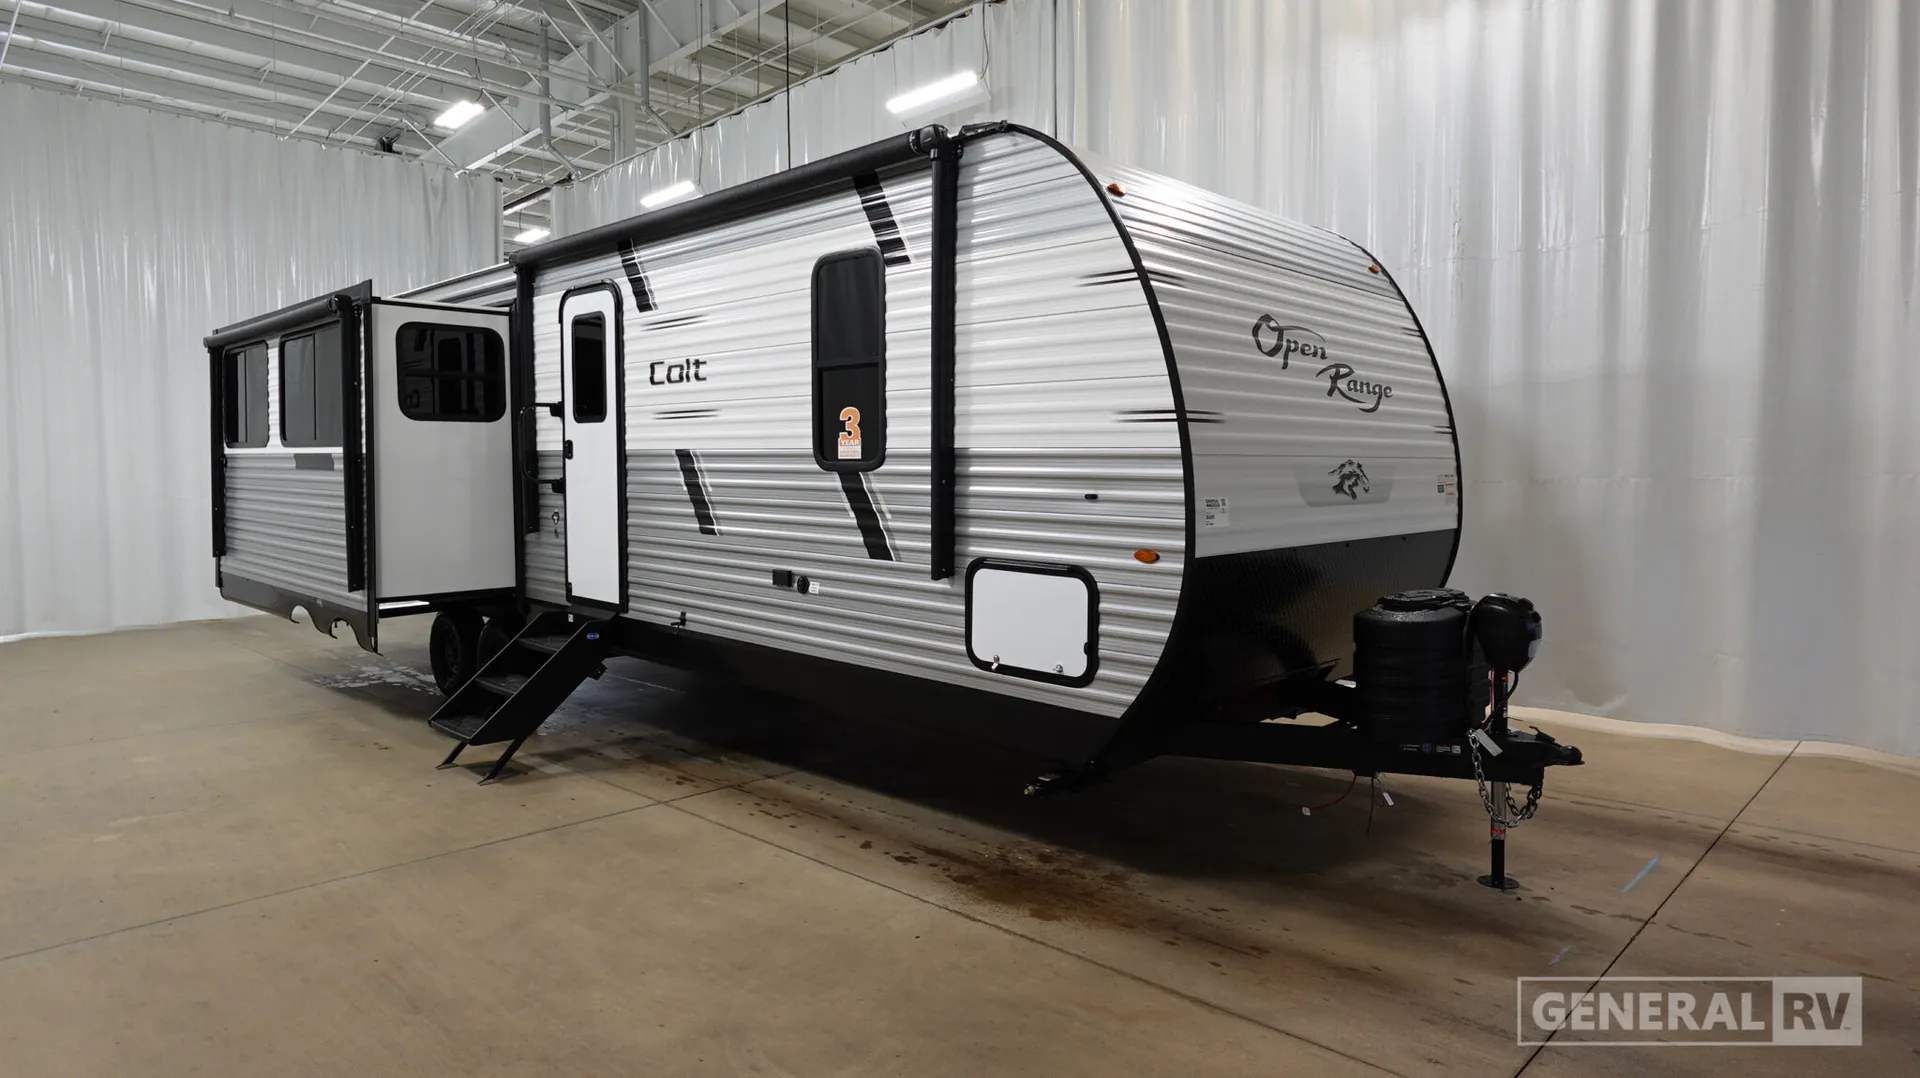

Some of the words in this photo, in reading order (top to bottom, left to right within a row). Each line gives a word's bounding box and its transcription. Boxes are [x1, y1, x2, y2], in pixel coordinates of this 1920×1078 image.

[1252, 313, 1328, 370] Open
[649, 358, 707, 386] Colt
[1315, 363, 1394, 413] Range
[839, 406, 861, 440] 3
